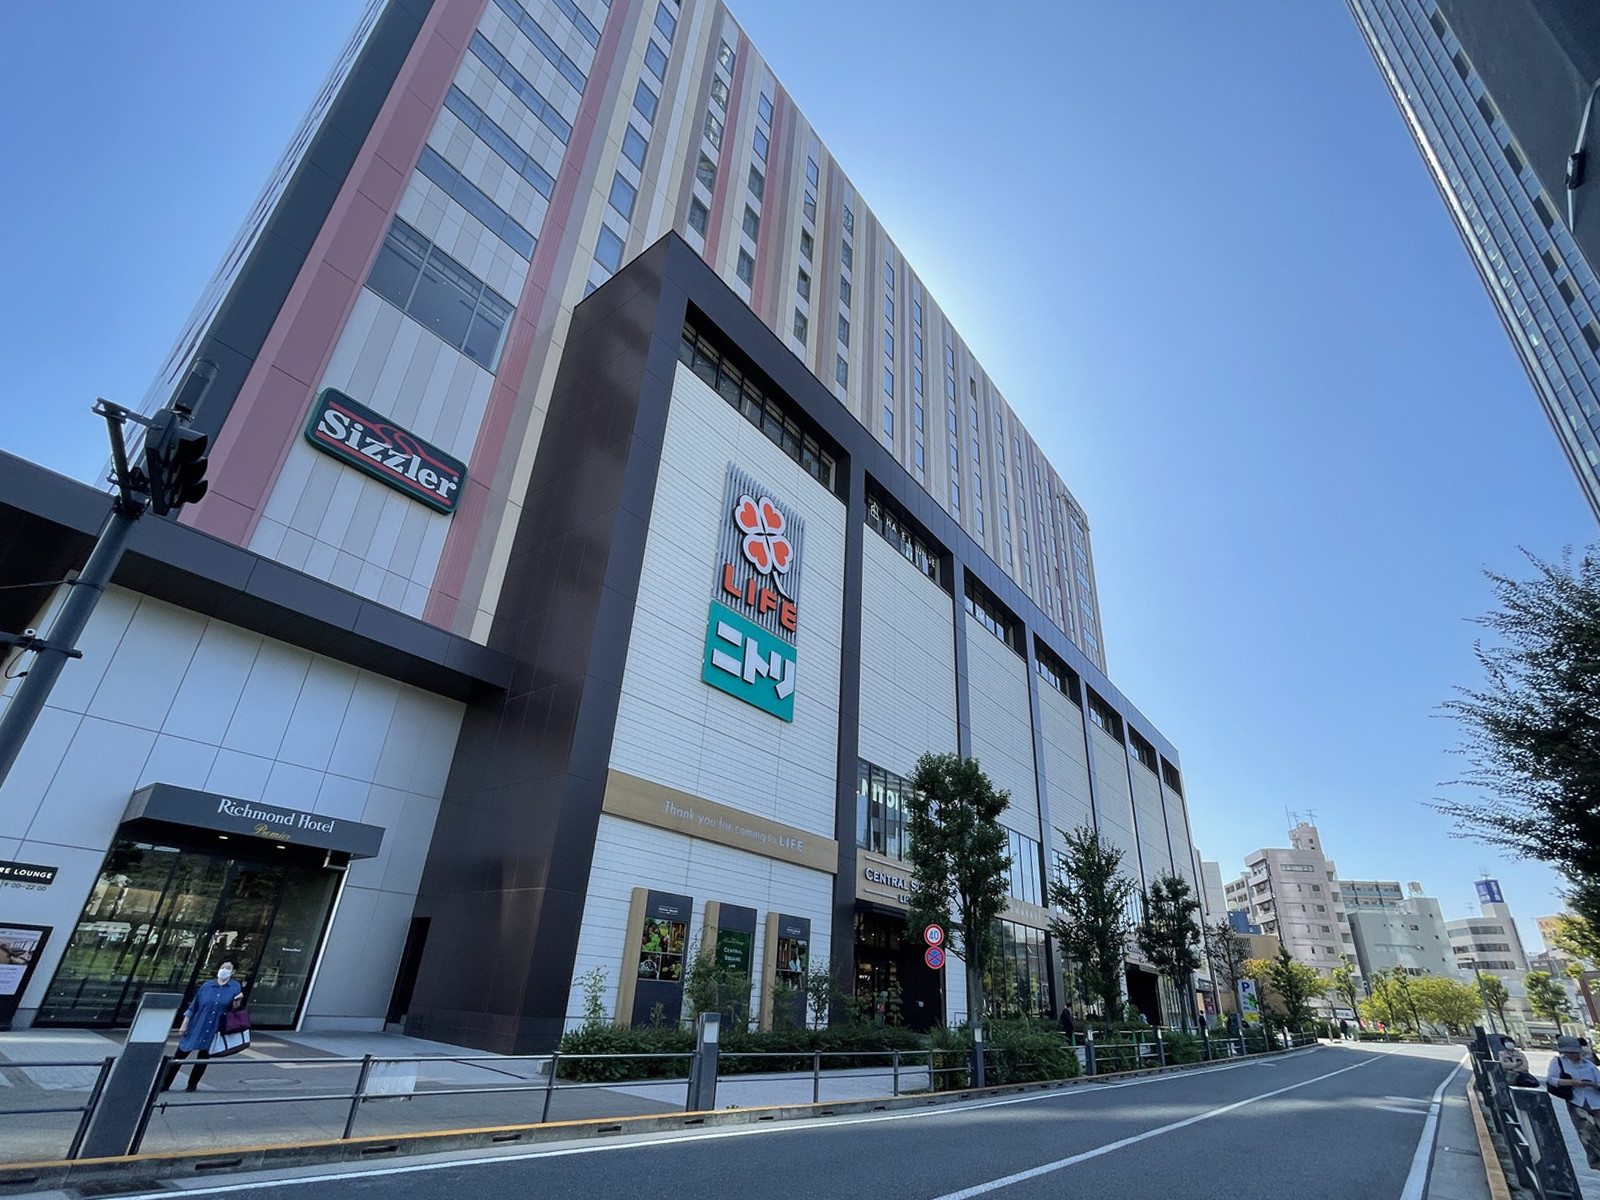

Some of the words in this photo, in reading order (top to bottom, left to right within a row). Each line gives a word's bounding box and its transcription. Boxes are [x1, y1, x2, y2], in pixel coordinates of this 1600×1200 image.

[318, 409, 457, 498] Sizzler
[724, 563, 797, 632] LIFE
[711, 620, 796, 700] ニトリ
[217, 798, 296, 826] Richmond
[298, 814, 336, 833] Hotel
[664, 800, 694, 820] Thank
[698, 815, 717, 827] you
[718, 816, 733, 832] for
[734, 826, 766, 843] coming
[779, 835, 805, 852] LIFE
[254, 823, 291, 841] Premier
[13, 869, 53, 879] LOUNGE
[865, 867, 908, 891] CENTRAL
[928, 930, 940, 941] 40
[1241, 981, 1250, 993] P
